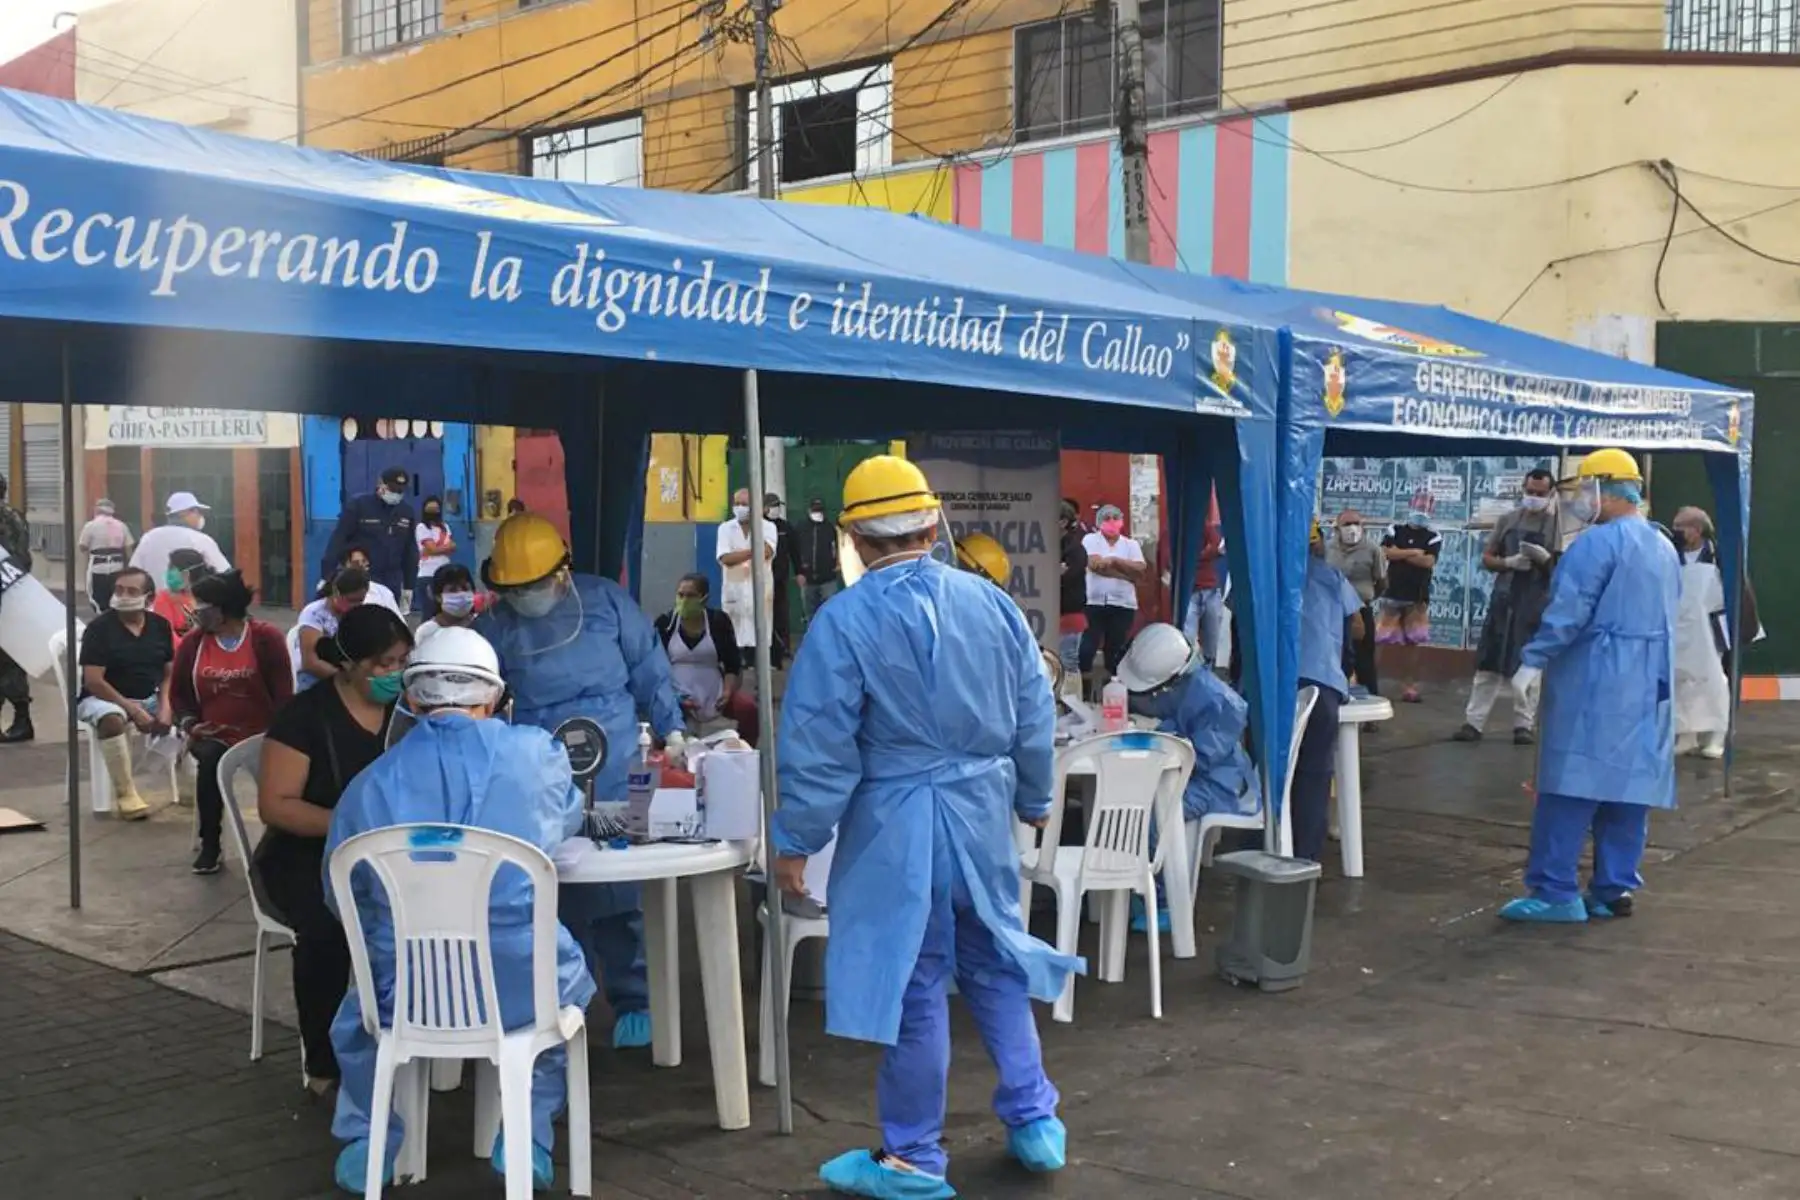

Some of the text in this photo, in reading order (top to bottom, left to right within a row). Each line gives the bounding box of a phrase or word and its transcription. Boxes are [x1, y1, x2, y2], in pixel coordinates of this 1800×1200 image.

[0, 180, 439, 295] Recuperando
[470, 231, 522, 301] la
[551, 242, 770, 332] dignidad
[789, 292, 811, 331] e
[831, 282, 1007, 356] identidad
[1019, 310, 1069, 364] del
[1416, 361, 1508, 403] GERENCIA
[1507, 412, 1555, 438] LOCAL
[1563, 415, 1574, 440] Y
[1325, 475, 1391, 493] ZAPEROKO
